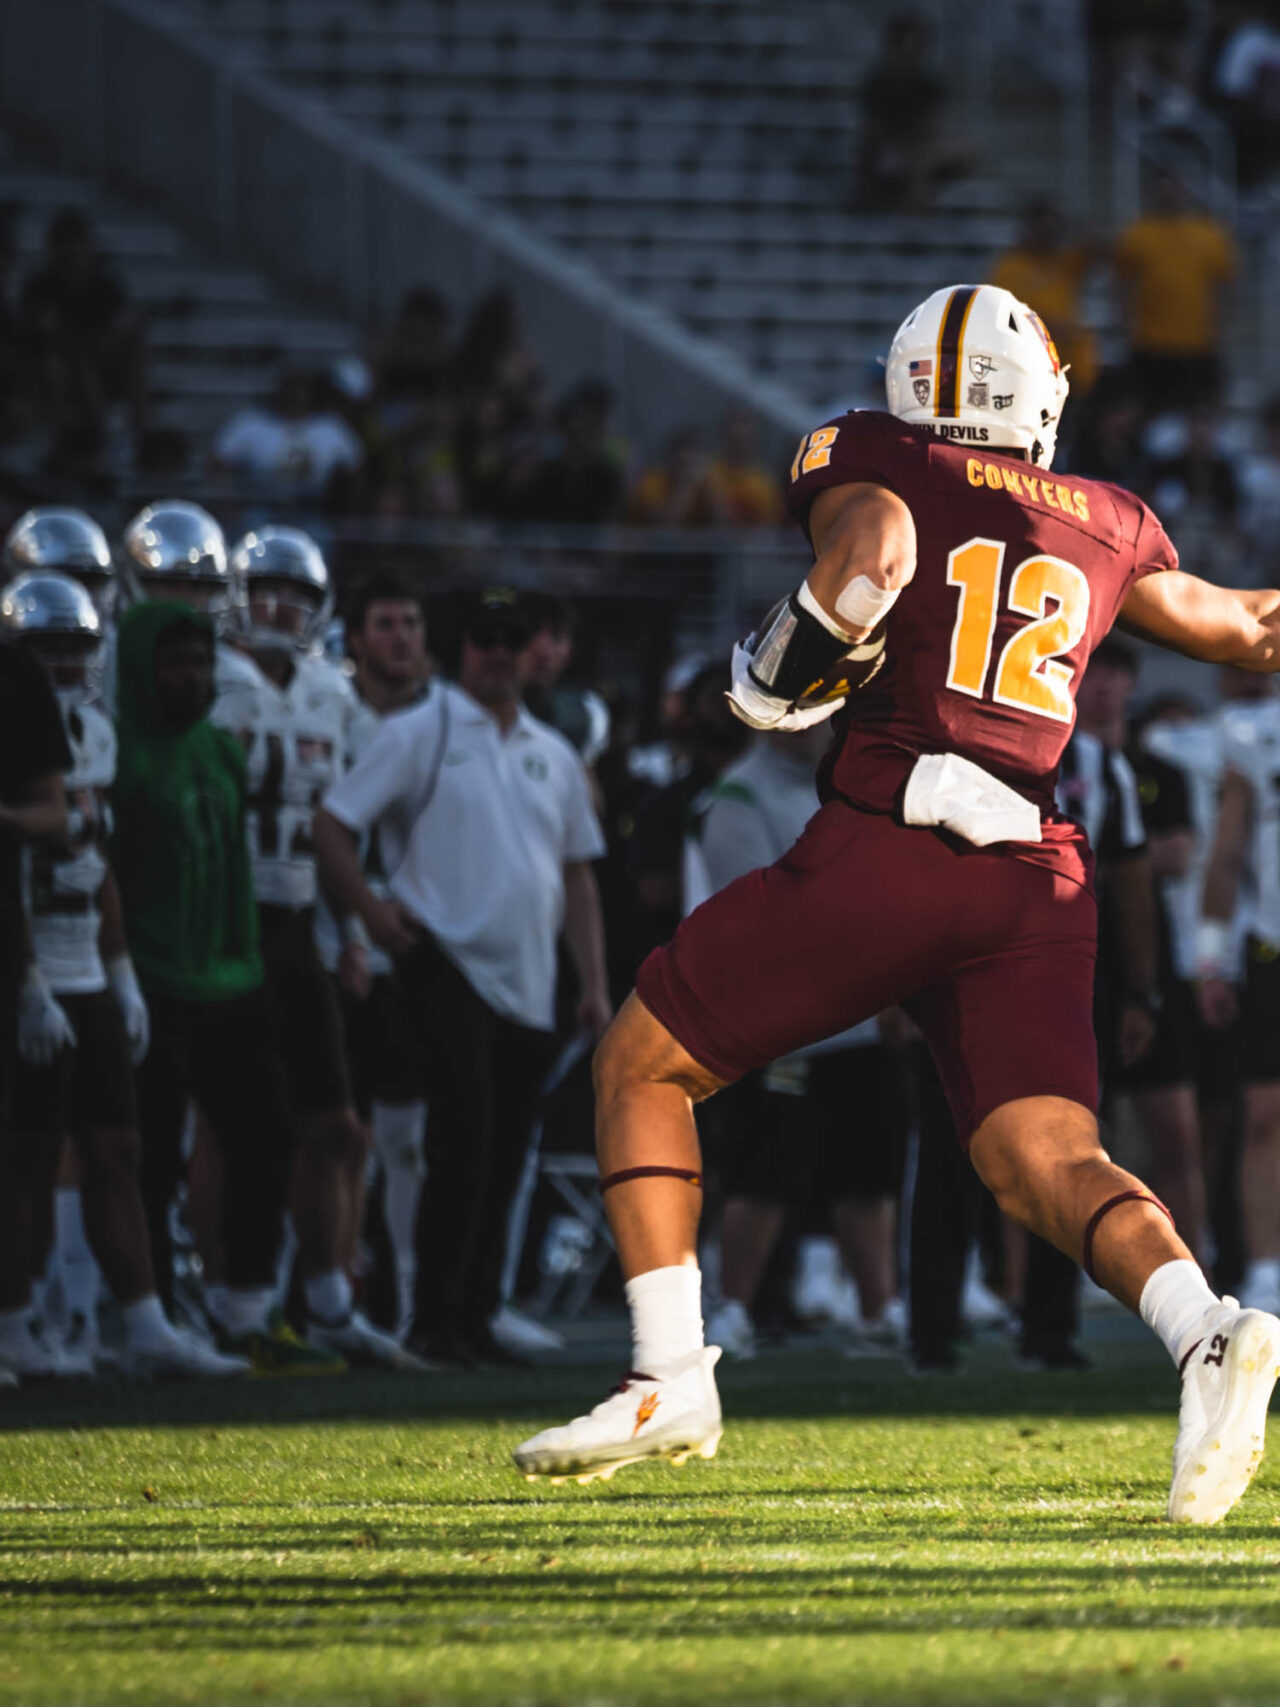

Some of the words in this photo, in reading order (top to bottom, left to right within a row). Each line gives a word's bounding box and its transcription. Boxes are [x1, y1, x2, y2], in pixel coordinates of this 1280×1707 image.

[940, 424, 988, 441] DEVILS
[966, 458, 1089, 522] CONYERS
[946, 537, 1091, 724] 12
[1203, 1333, 1229, 1367] 12
